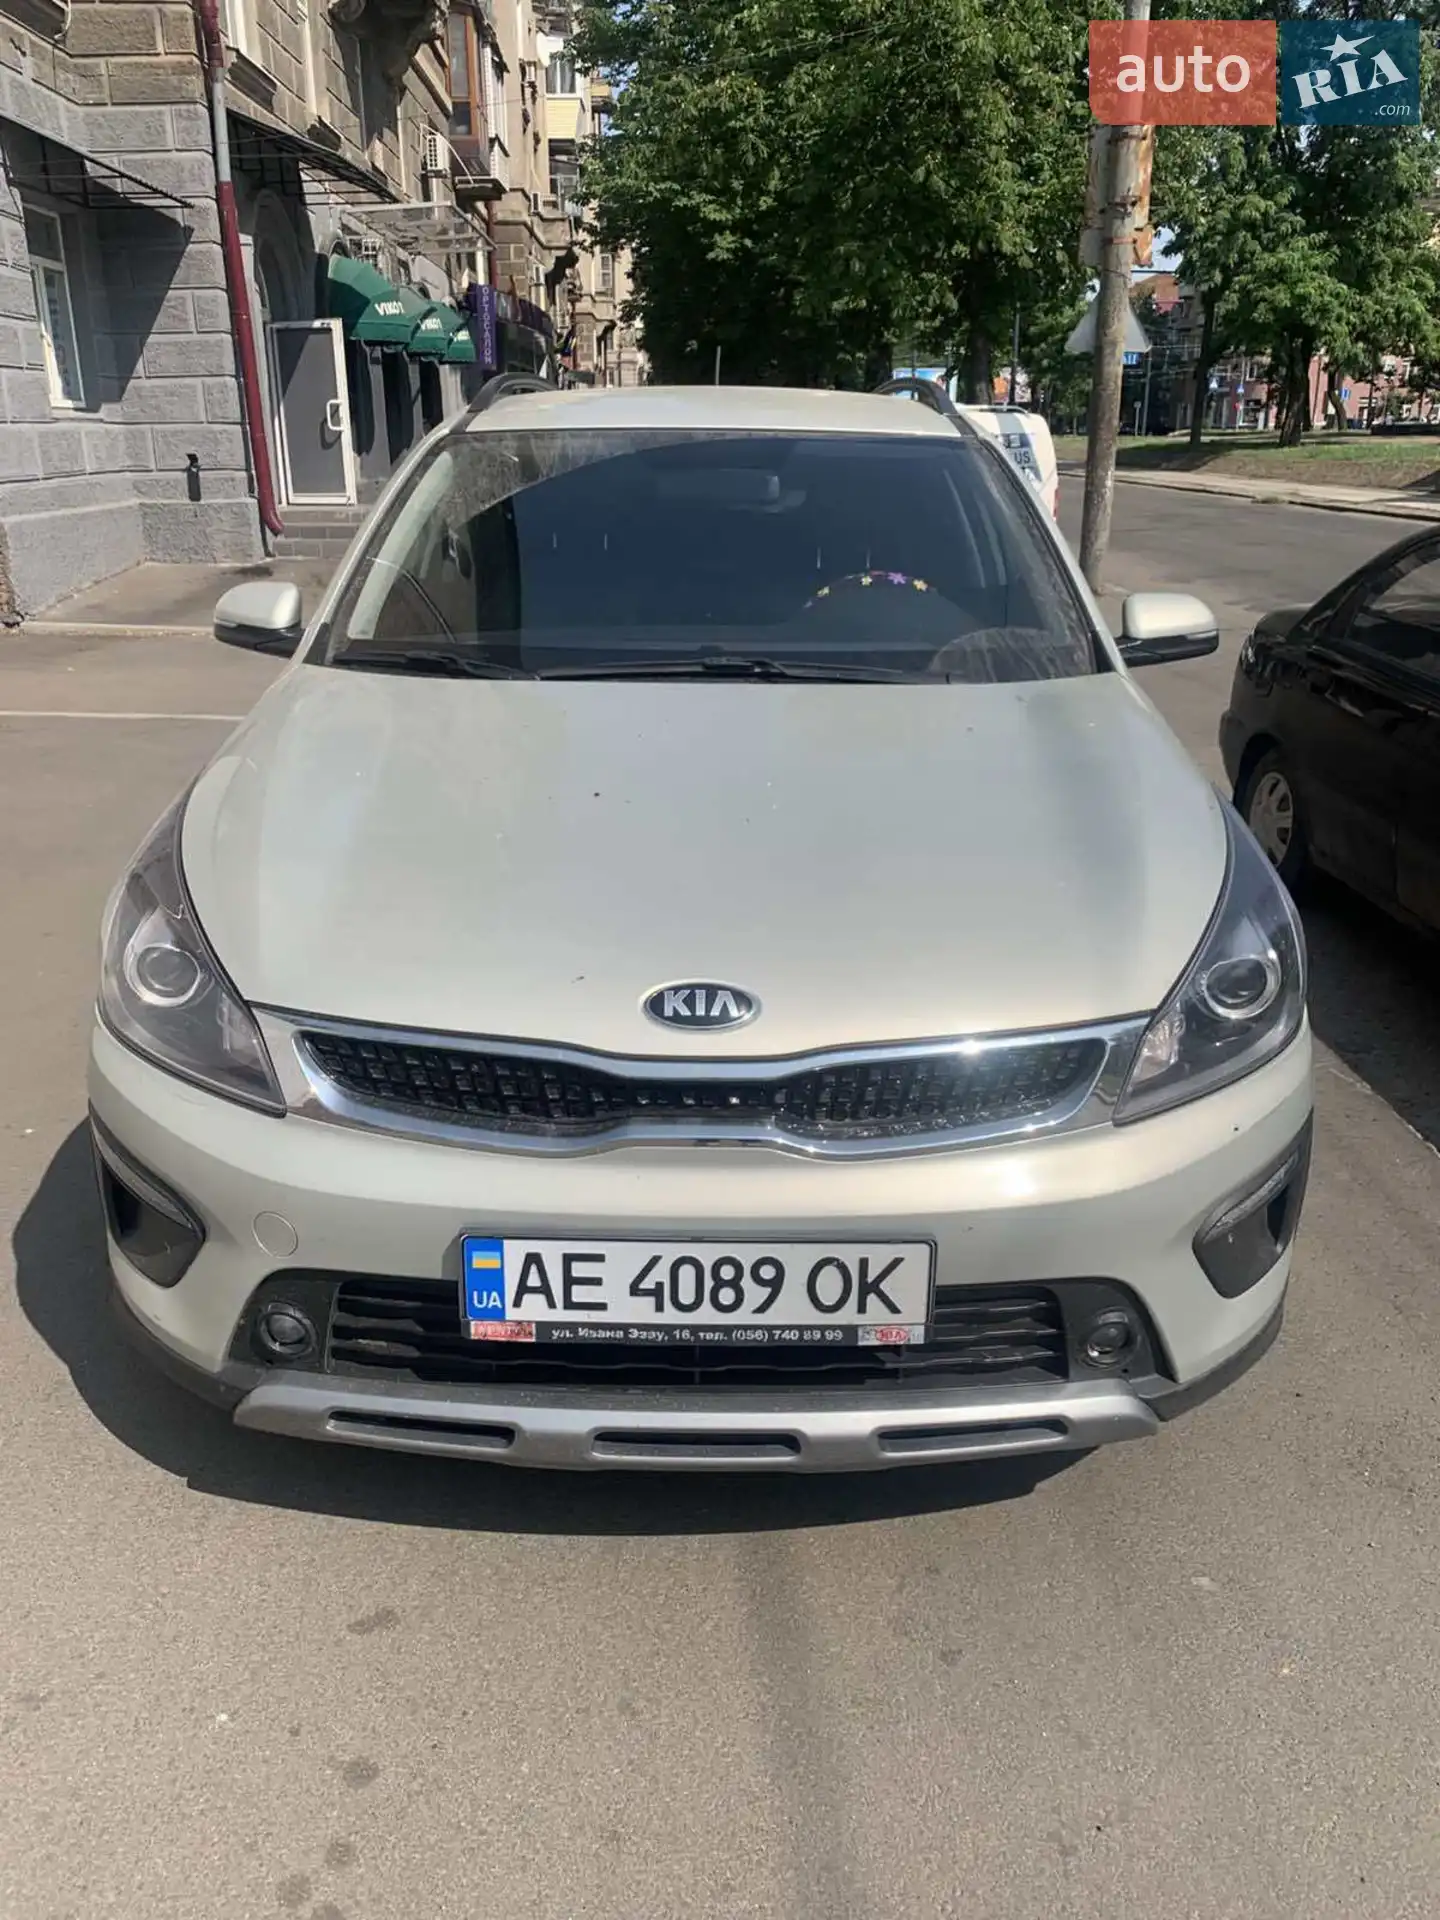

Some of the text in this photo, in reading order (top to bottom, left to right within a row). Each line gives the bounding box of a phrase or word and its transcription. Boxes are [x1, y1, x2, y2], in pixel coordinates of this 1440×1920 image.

[481, 286, 493, 365] ОРТОСАЛОН
[663, 989, 741, 1017] KIA
[512, 1251, 905, 1315] AE 4089 OK
[473, 1290, 502, 1309] UA
[772, 1330, 799, 1341] 740
